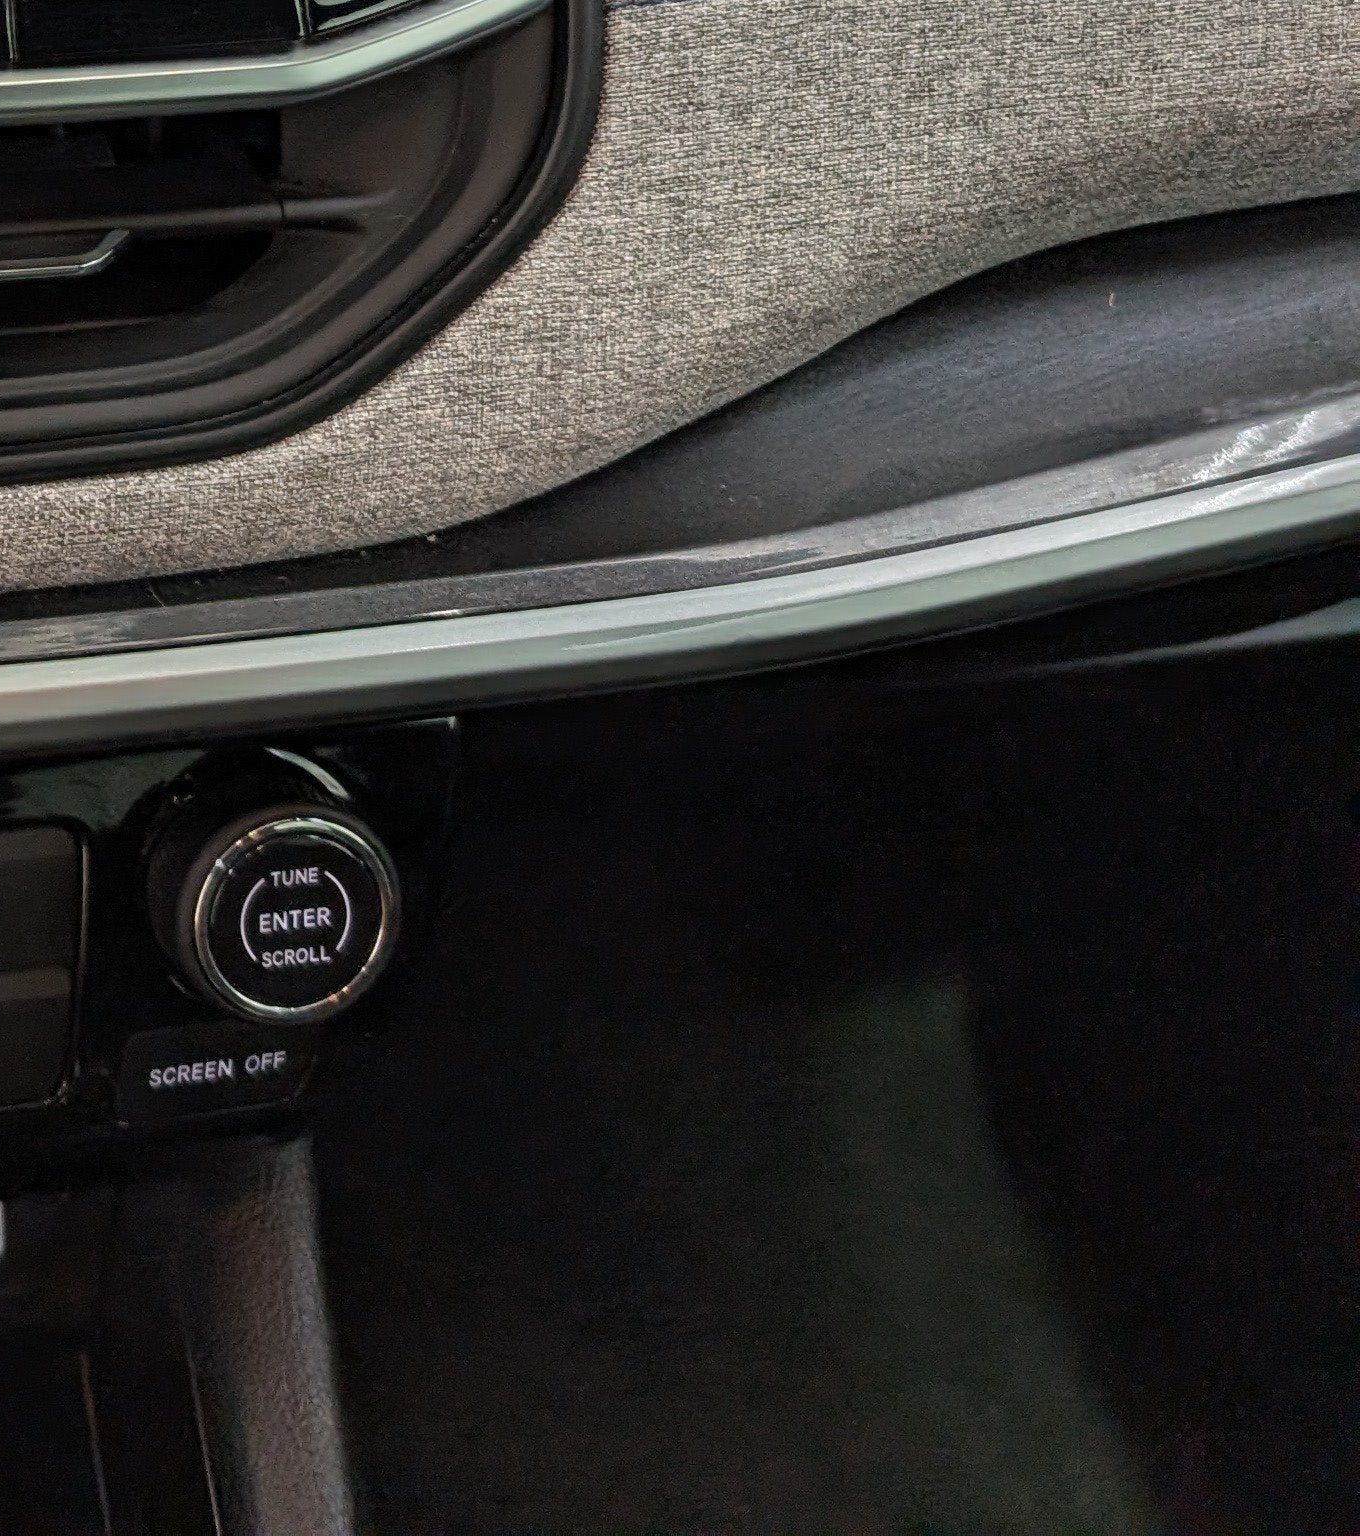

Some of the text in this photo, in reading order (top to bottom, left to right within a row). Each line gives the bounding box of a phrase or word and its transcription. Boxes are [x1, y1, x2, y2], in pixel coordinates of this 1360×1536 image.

[269, 866, 319, 887] TUNE
[259, 906, 332, 934] ENTER
[261, 945, 331, 968] SCROLL
[148, 1050, 286, 1088] SCREEN OFF
